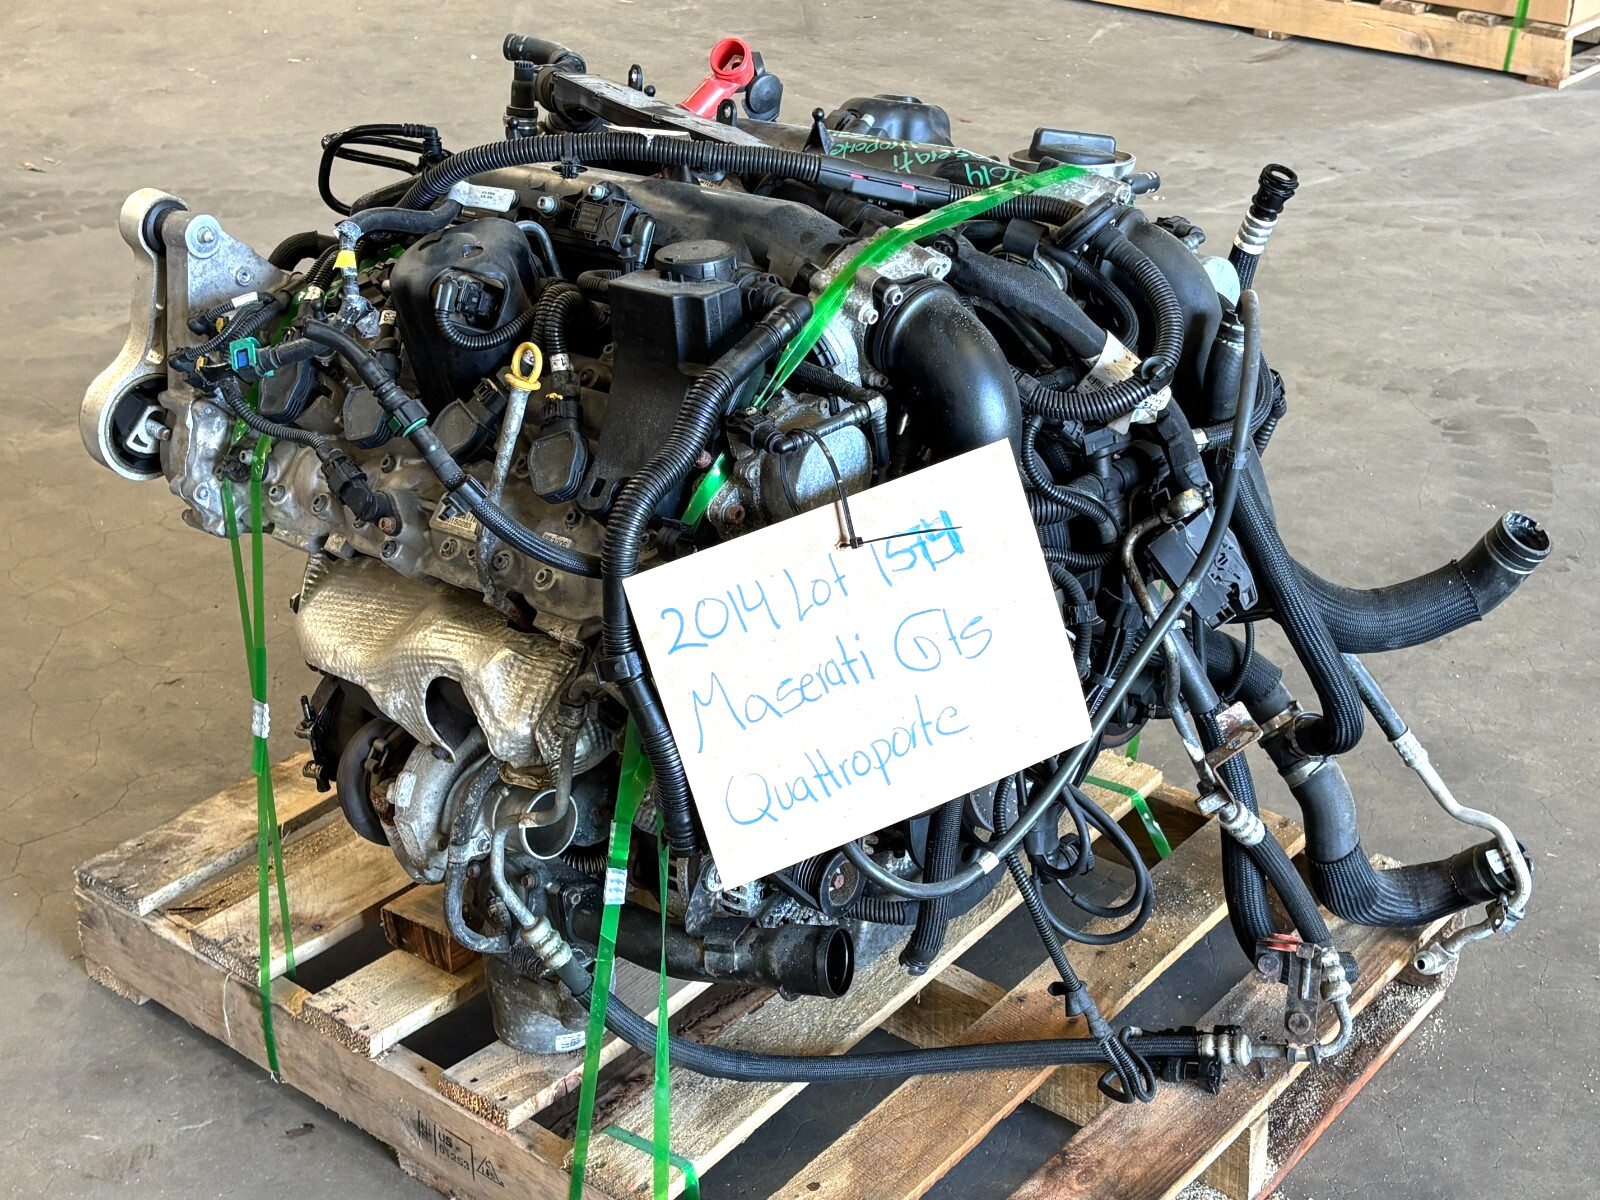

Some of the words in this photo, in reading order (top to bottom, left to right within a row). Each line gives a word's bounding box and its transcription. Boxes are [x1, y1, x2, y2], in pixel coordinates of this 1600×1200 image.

[661, 580, 781, 655] 2014
[783, 554, 849, 621] Lot
[692, 635, 875, 753] Maserati
[726, 695, 969, 825] Quattroporte
